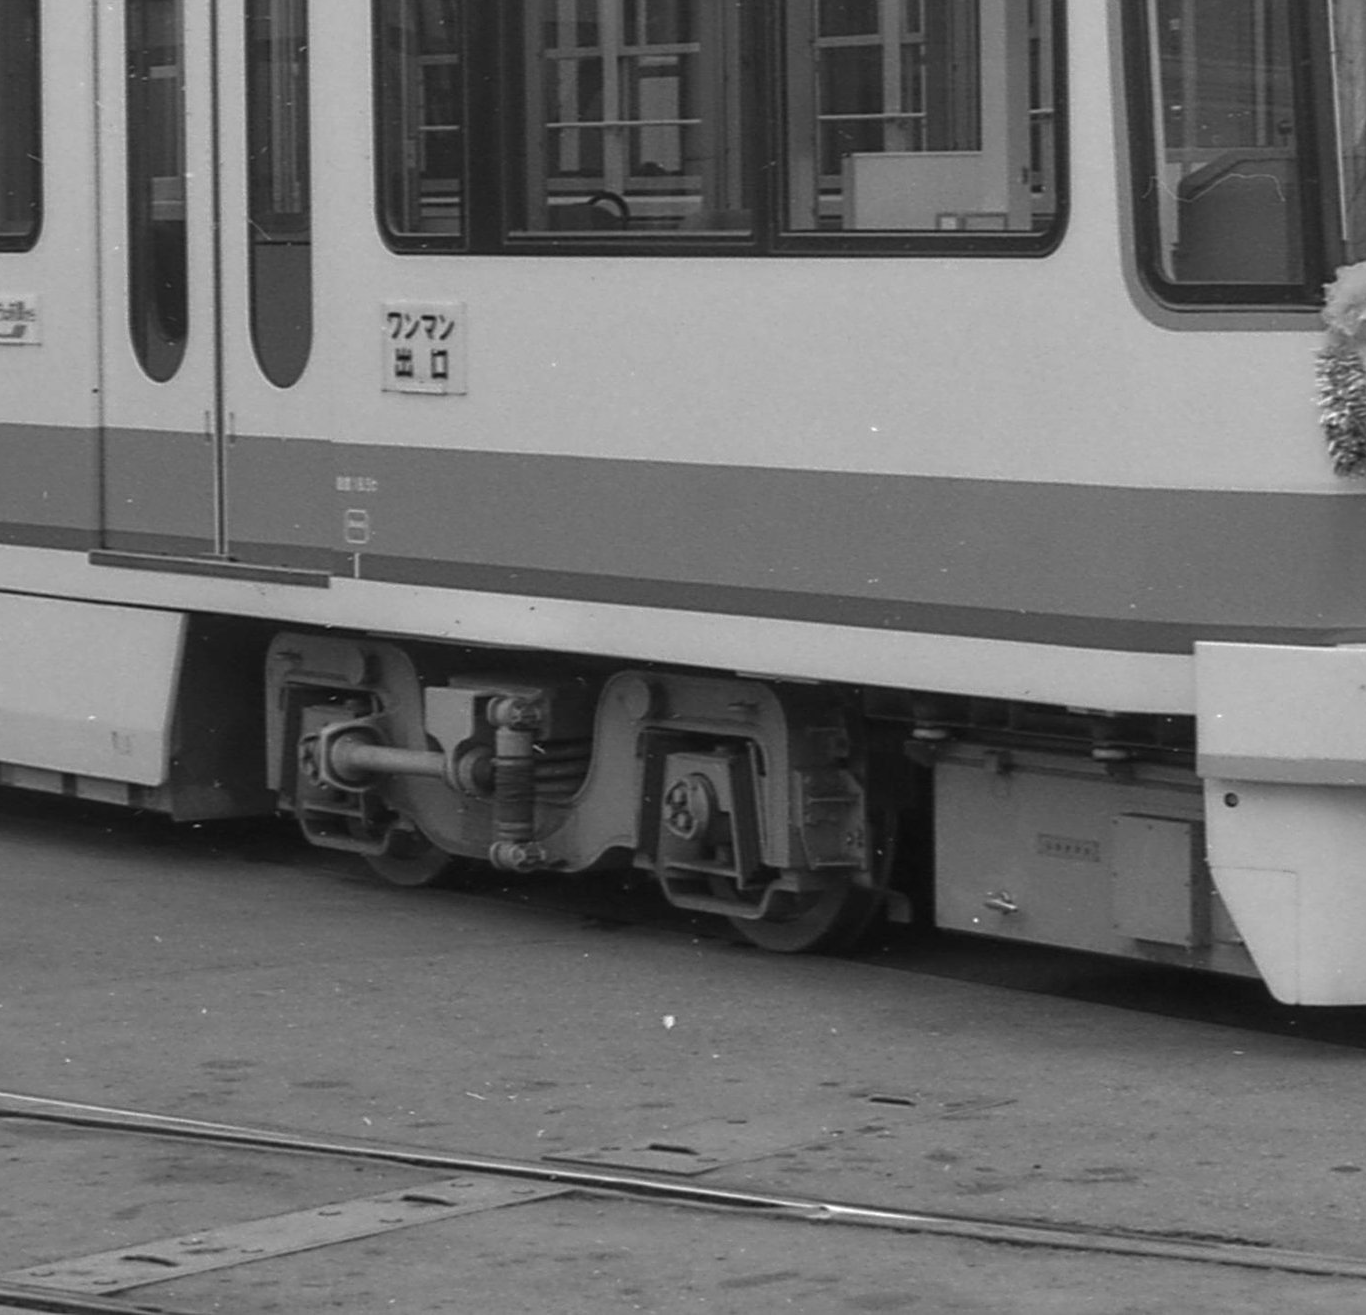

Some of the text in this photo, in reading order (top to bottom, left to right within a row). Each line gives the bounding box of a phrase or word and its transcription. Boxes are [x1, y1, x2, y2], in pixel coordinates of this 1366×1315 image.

[387, 312, 455, 340] ワンマン
[395, 348, 449, 379] 出口
